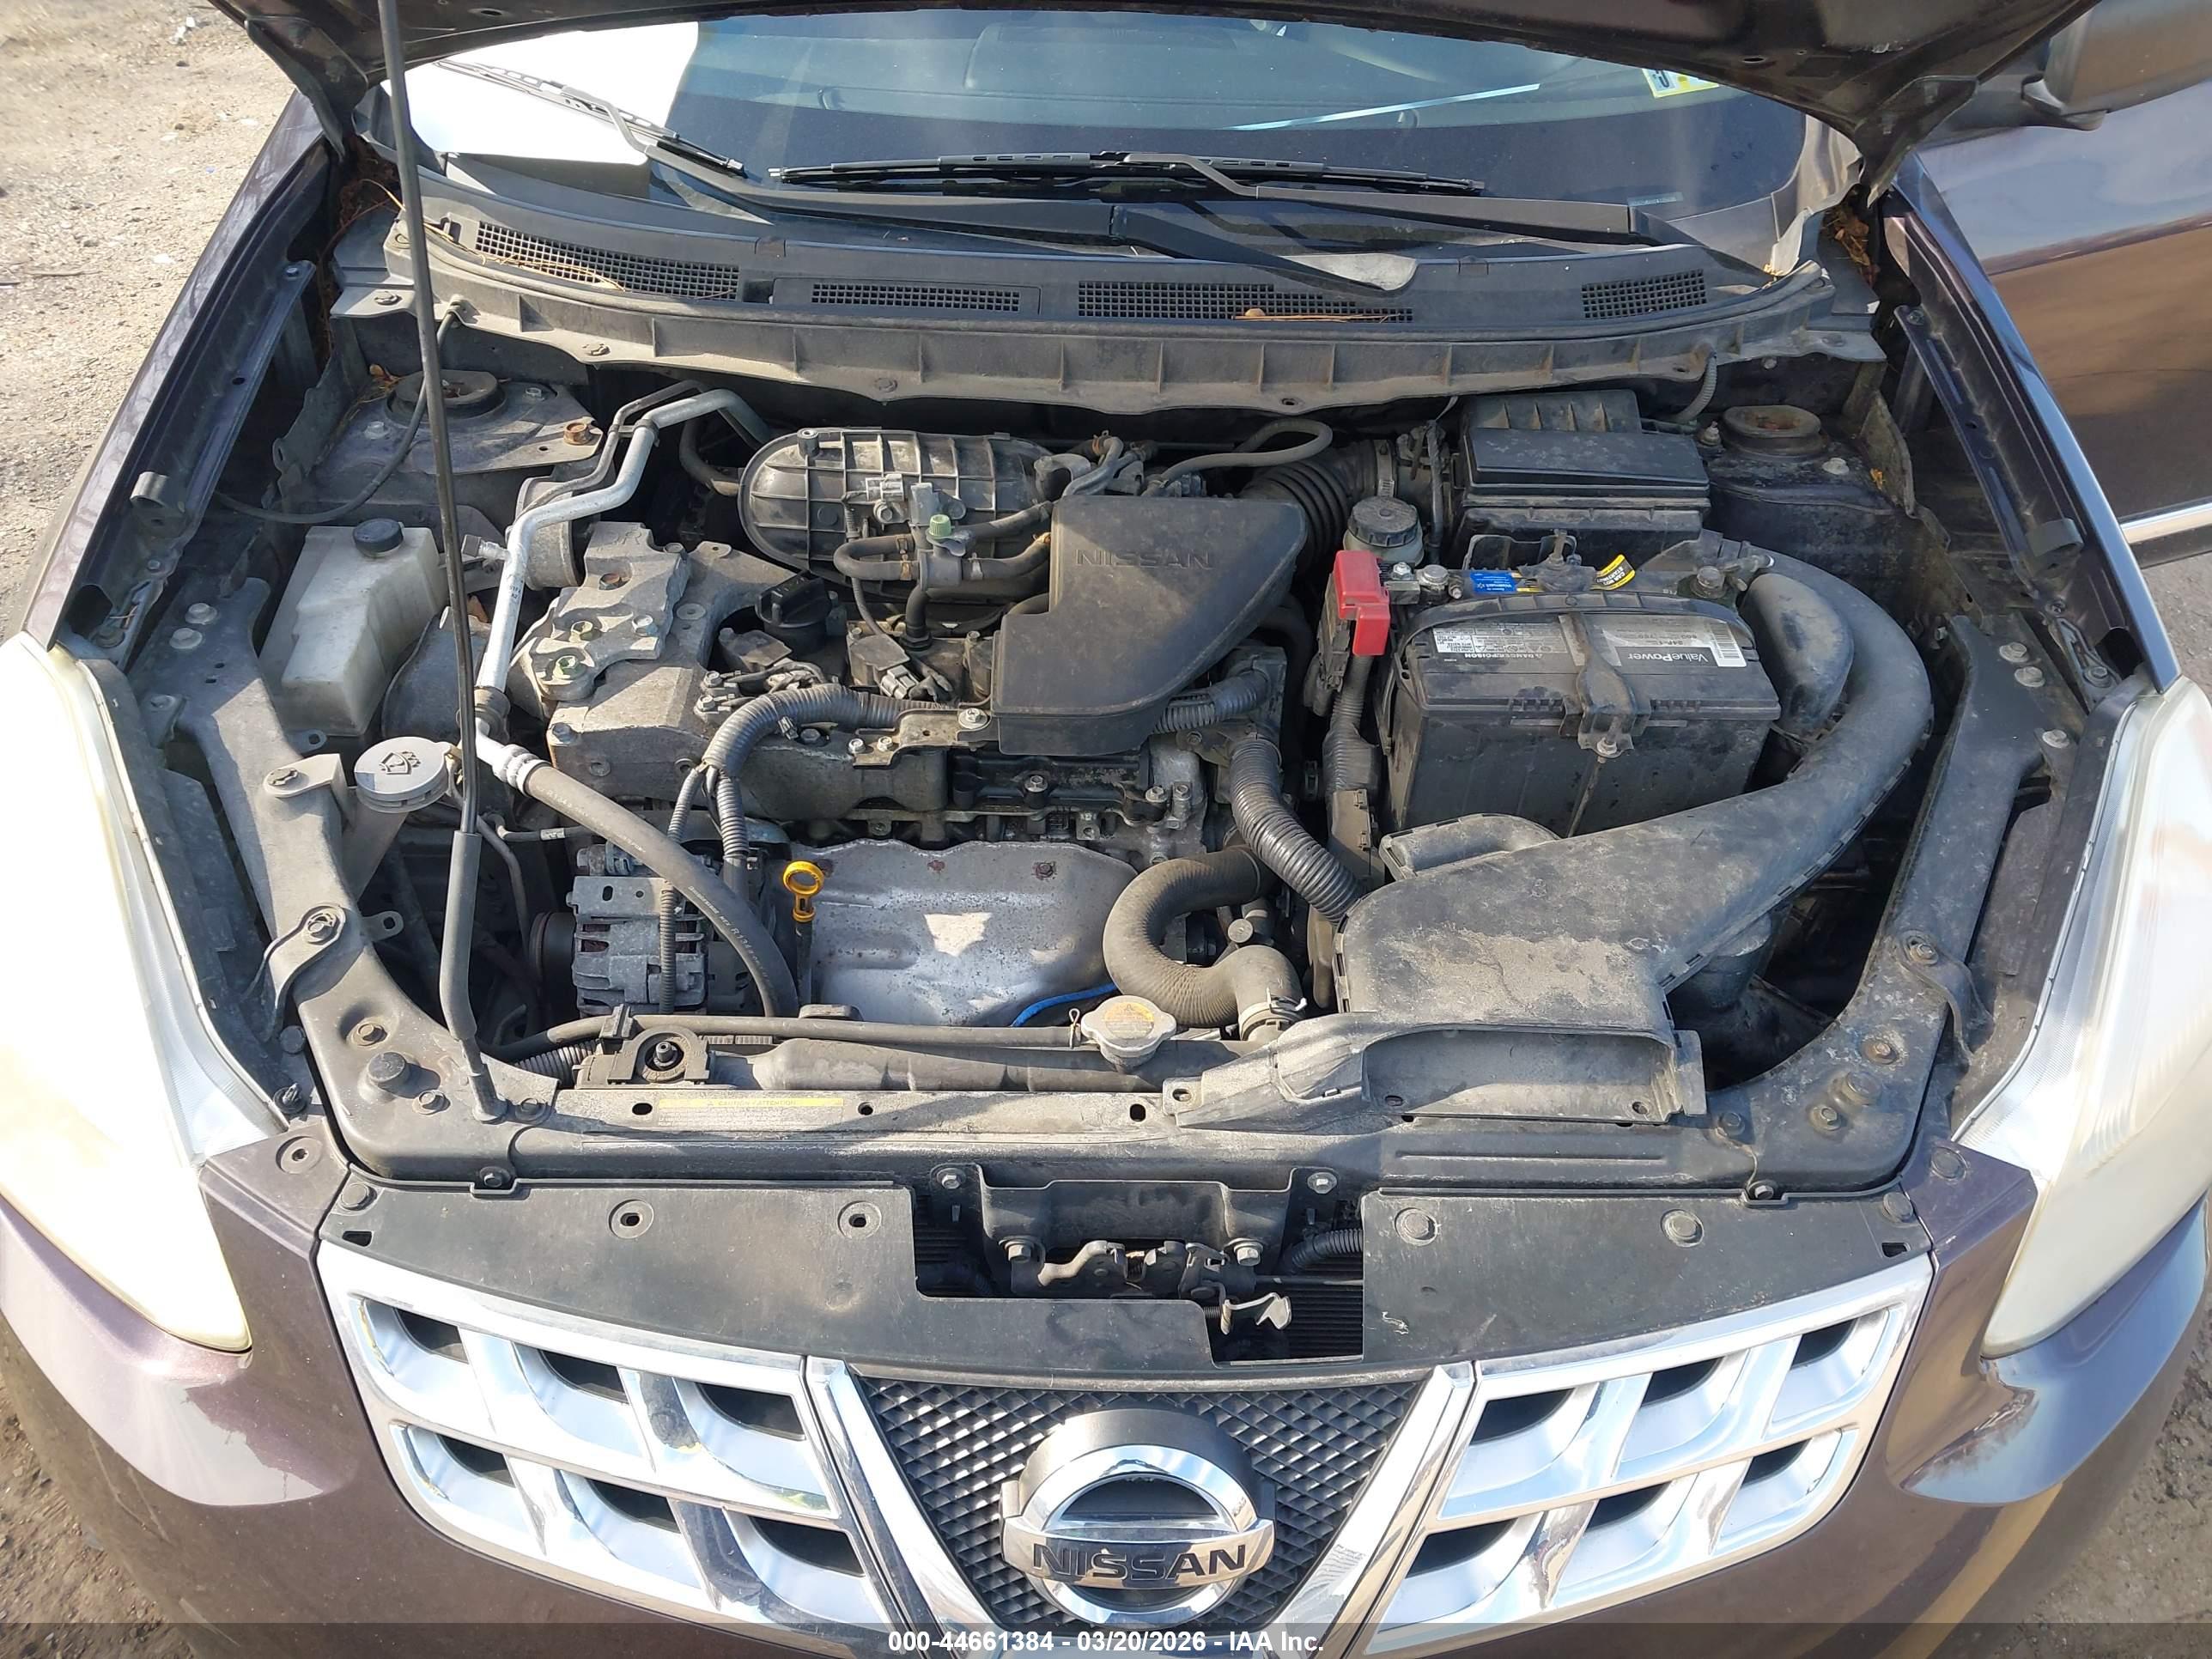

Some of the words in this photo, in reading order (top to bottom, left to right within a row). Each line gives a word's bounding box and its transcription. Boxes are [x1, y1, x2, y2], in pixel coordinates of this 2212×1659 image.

[1075, 549, 1215, 570] NISSAN
[1627, 653, 1709, 663] ValuePower
[1033, 1544, 1246, 1581] NISSAN
